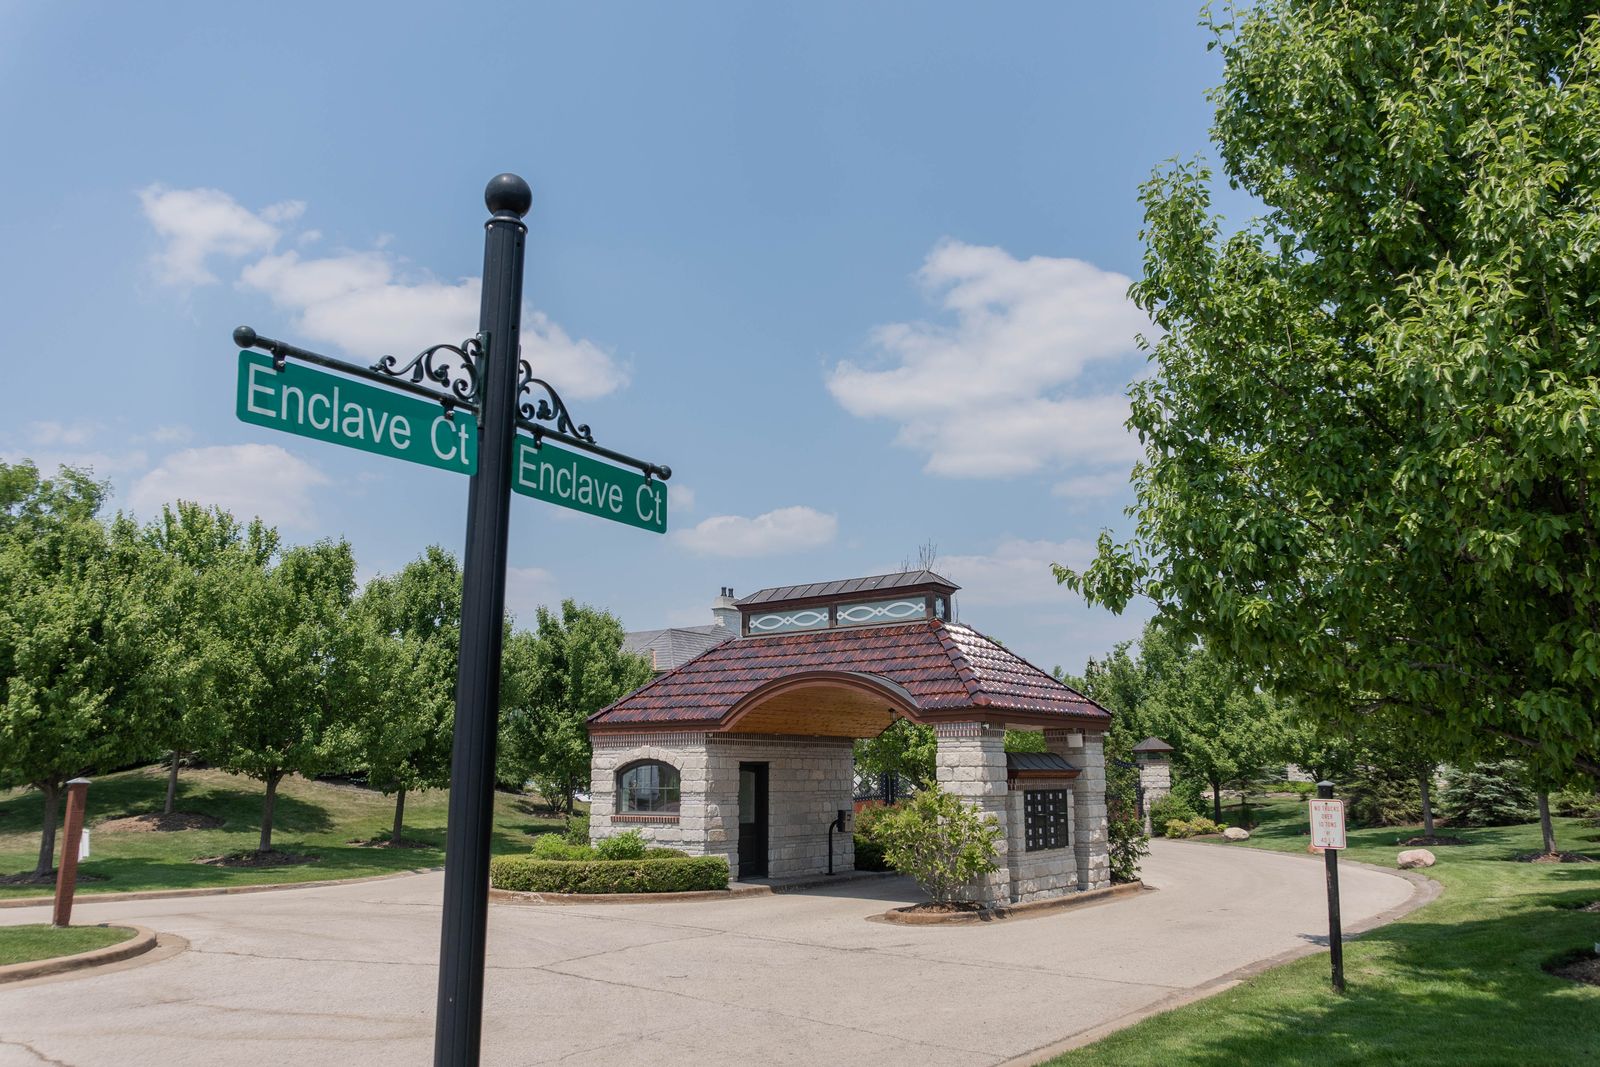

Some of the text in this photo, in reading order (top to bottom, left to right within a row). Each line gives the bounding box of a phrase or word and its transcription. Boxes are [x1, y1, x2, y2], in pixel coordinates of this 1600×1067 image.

[247, 362, 469, 465] Enclave Ct
[518, 444, 662, 525] Enclave Ct
